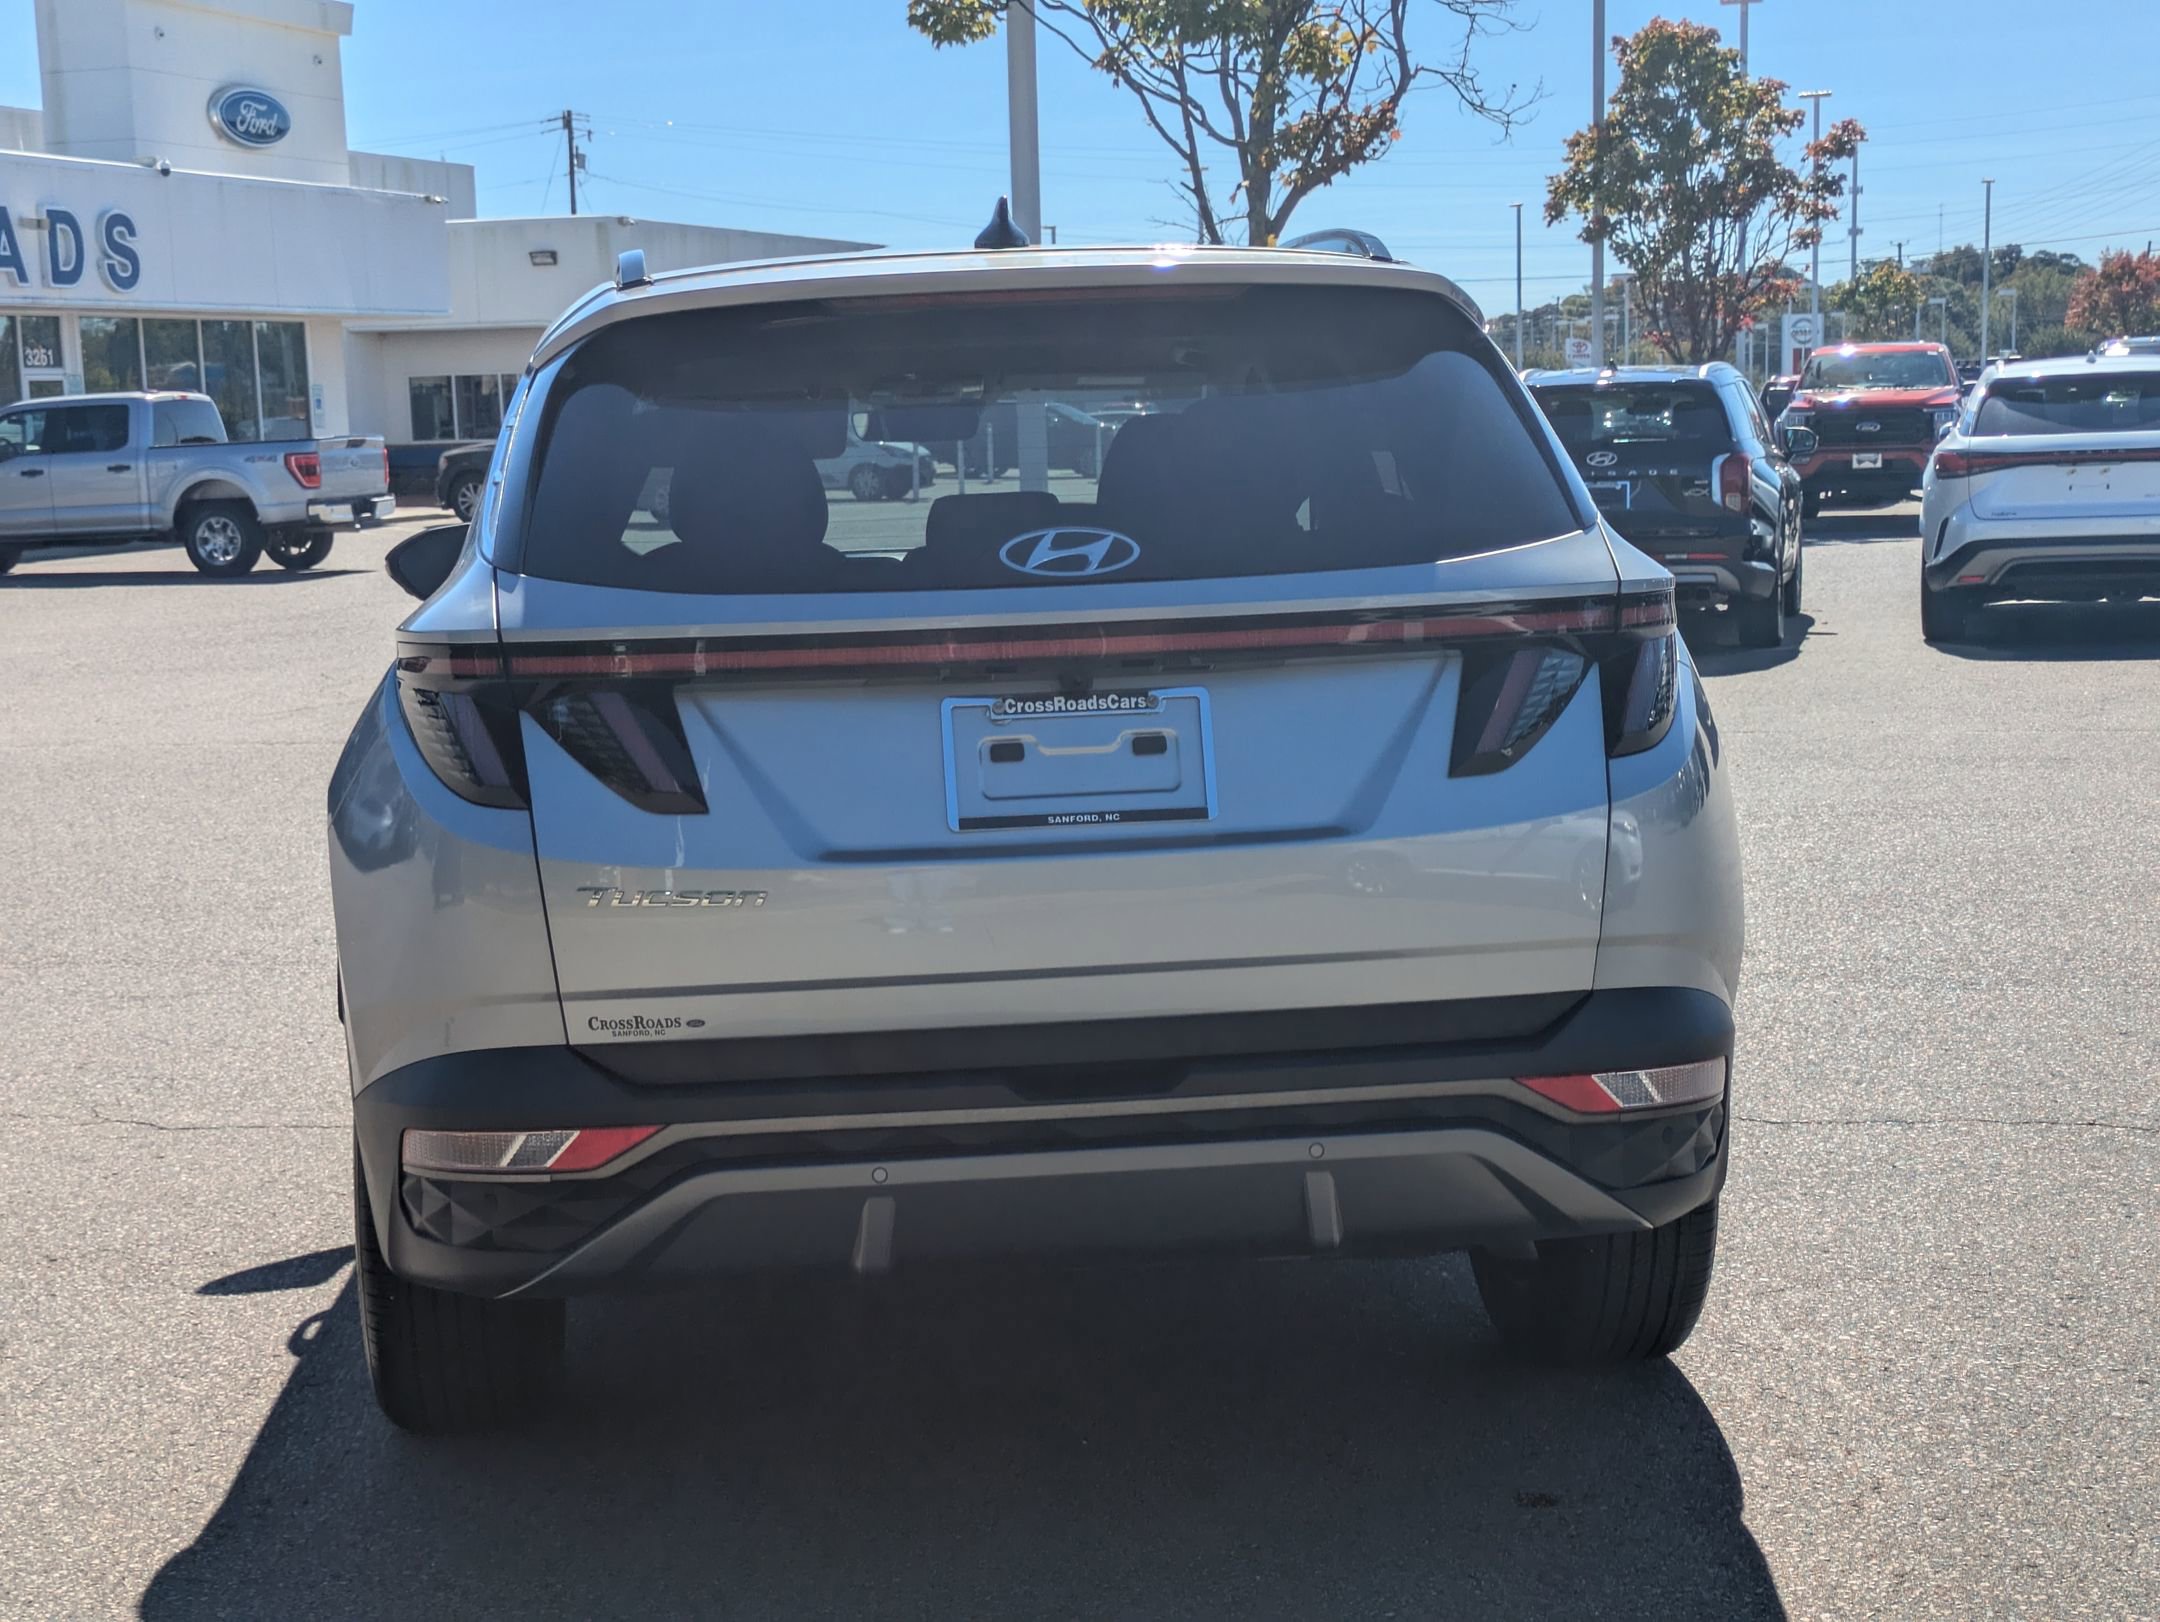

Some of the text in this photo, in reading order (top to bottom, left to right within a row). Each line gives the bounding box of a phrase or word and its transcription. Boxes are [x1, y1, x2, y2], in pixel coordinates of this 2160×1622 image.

[235, 101, 278, 137] Ford
[1004, 694, 1147, 714] CrossRoadsCars
[1047, 813, 1121, 824] SANFORD, NC
[612, 1028, 666, 1038] SANFORD, NC
